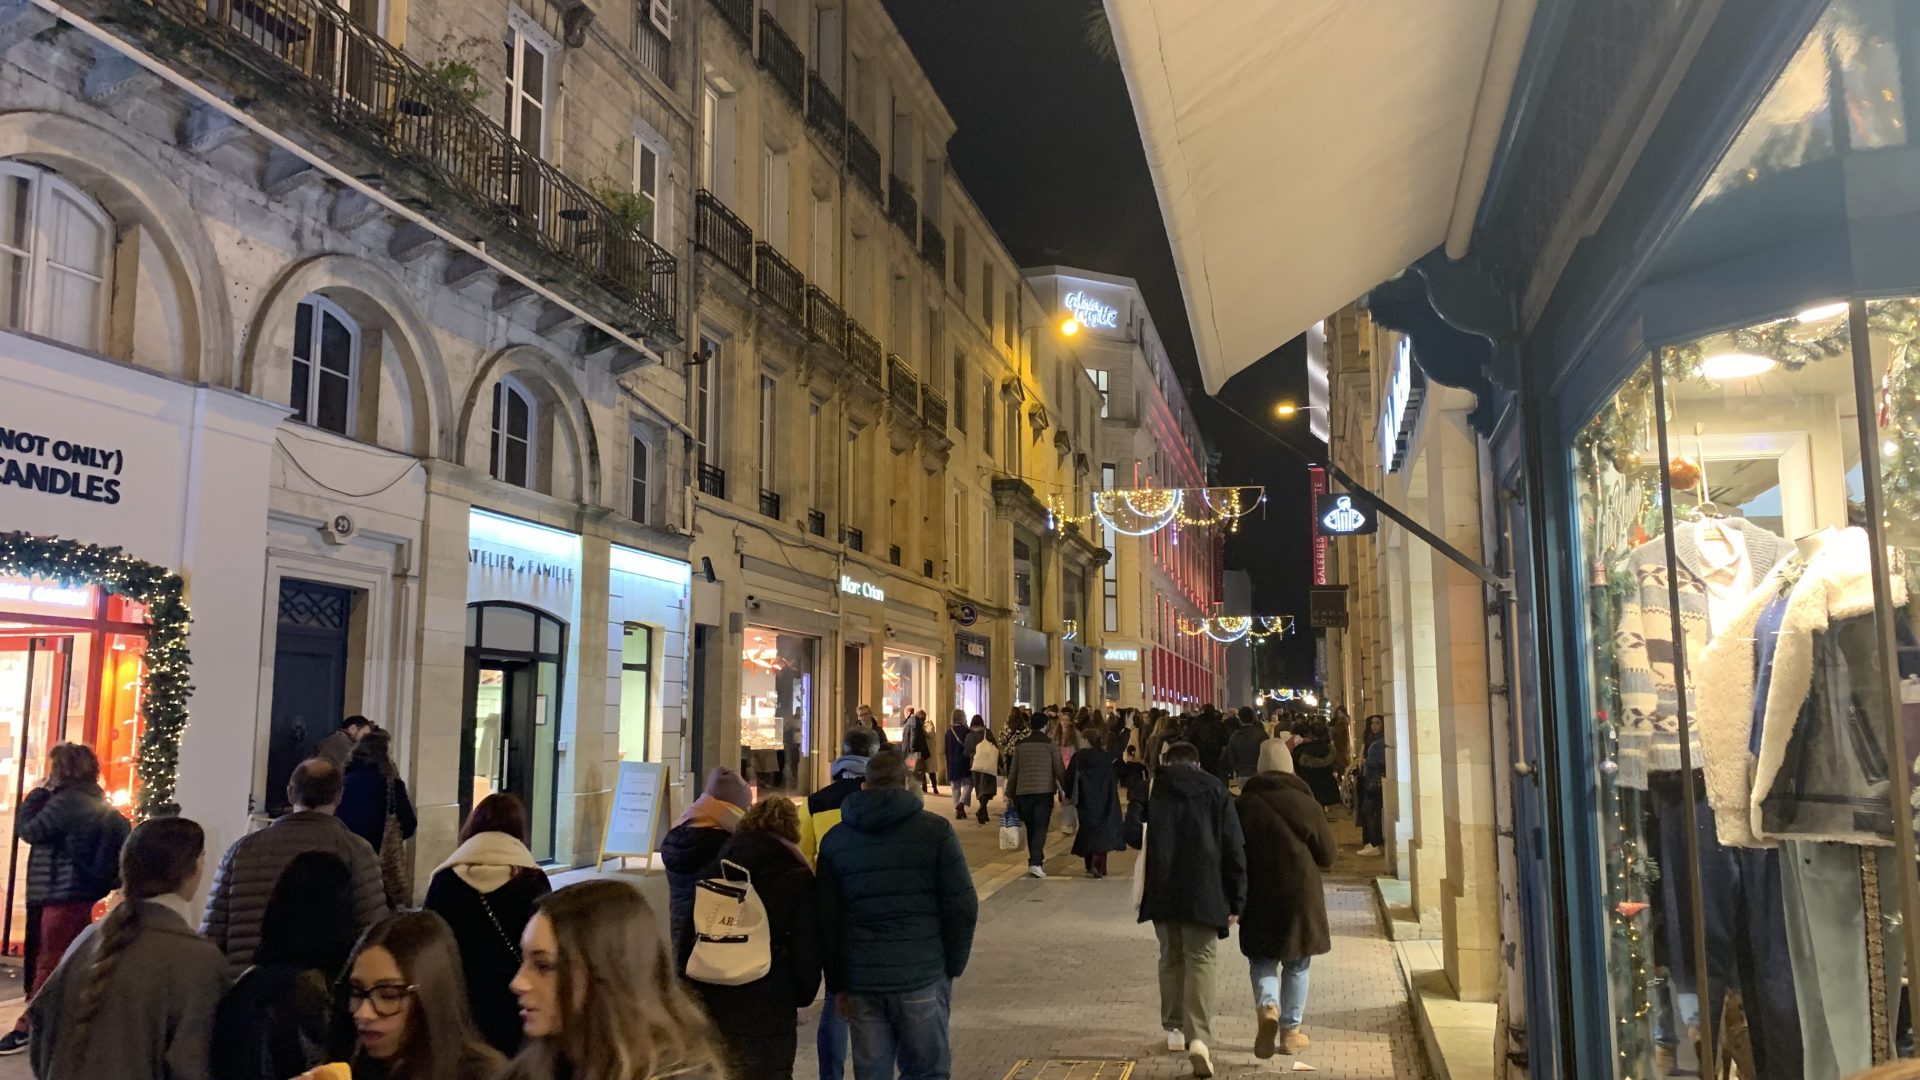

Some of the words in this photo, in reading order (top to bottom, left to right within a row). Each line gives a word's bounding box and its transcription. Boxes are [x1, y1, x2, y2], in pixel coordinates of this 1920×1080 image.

[52, 440, 123, 475] ONLY)
[0, 456, 121, 505] ANDLES
[528, 560, 574, 581] FAMILLE
[1316, 537, 1326, 585] GALERIES
